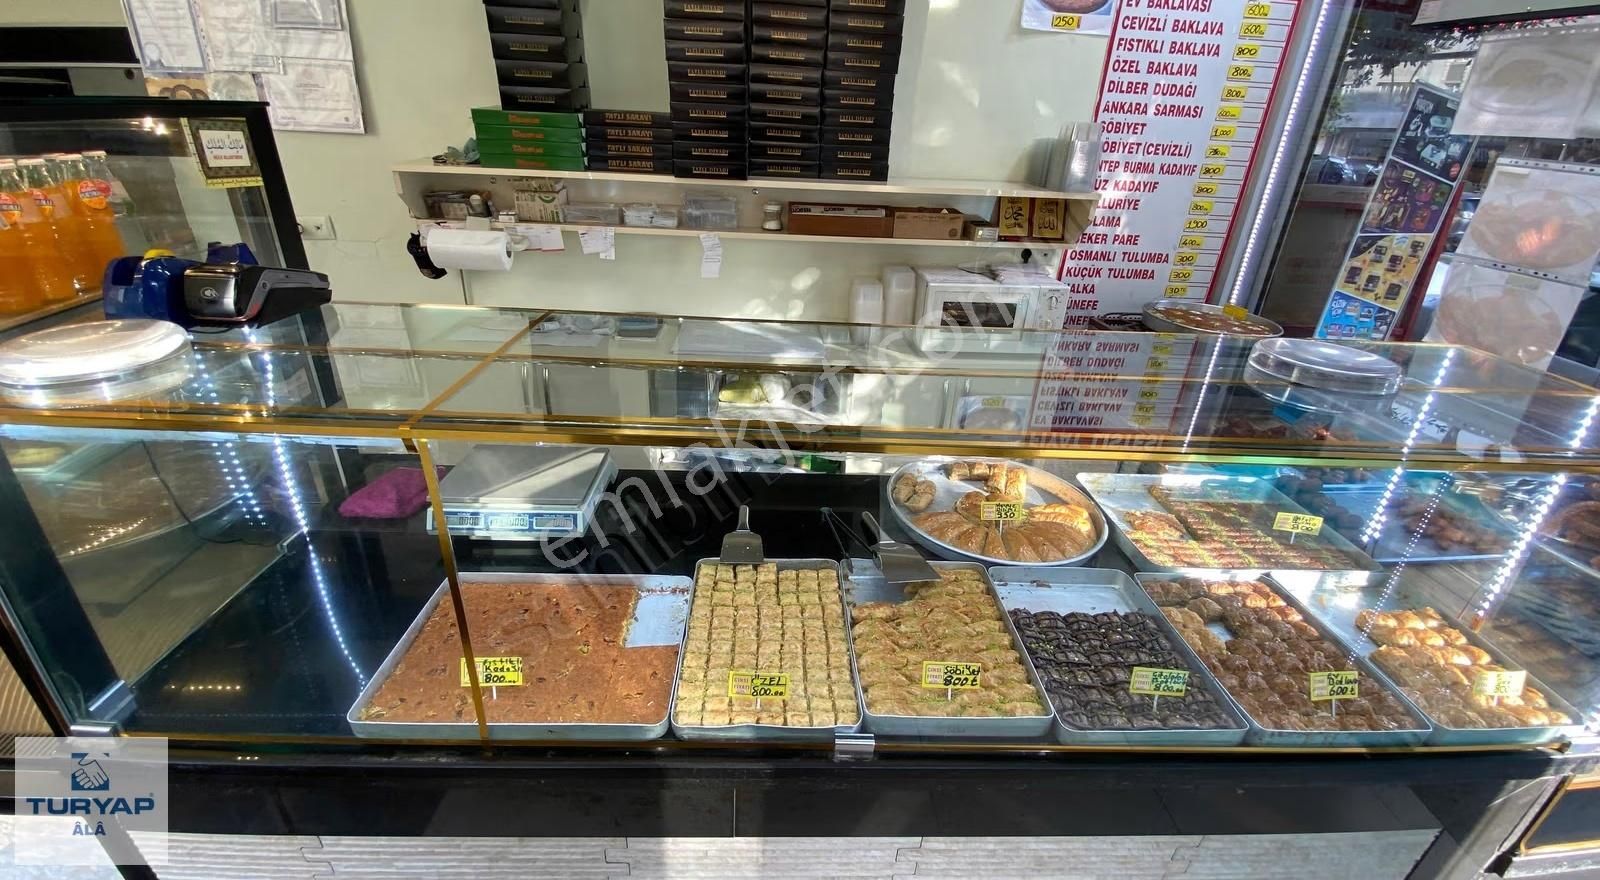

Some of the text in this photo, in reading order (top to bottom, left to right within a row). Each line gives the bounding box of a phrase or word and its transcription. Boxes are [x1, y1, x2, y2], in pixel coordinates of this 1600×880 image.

[1054, 17, 1074, 27] 250
[1121, 13, 1224, 36] CEVİZLİ BAKLAVA
[1116, 38, 1221, 57] FISTIKLI BAKLAVA
[1236, 47, 1258, 56] 800
[1112, 55, 1198, 77] ÖZEL BAKLAVA
[1107, 77, 1197, 98] DİLBER DUDAĞI
[1103, 101, 1204, 119] ANKARA SARMASI
[1123, 161, 1155, 174] BURMA
[1159, 163, 1197, 176] KADAYIF
[1094, 175, 1159, 193] ÜZ KADAYIF
[1092, 216, 1121, 227] LAMA
[1076, 233, 1140, 246] EKER PARE
[1069, 250, 1169, 264] OSMANLI TULUMBA
[1065, 264, 1155, 280] KÜÇÜK TULUMBA
[1068, 283, 1095, 295] ALKA
[1067, 297, 1098, 311] ÜNEFE
